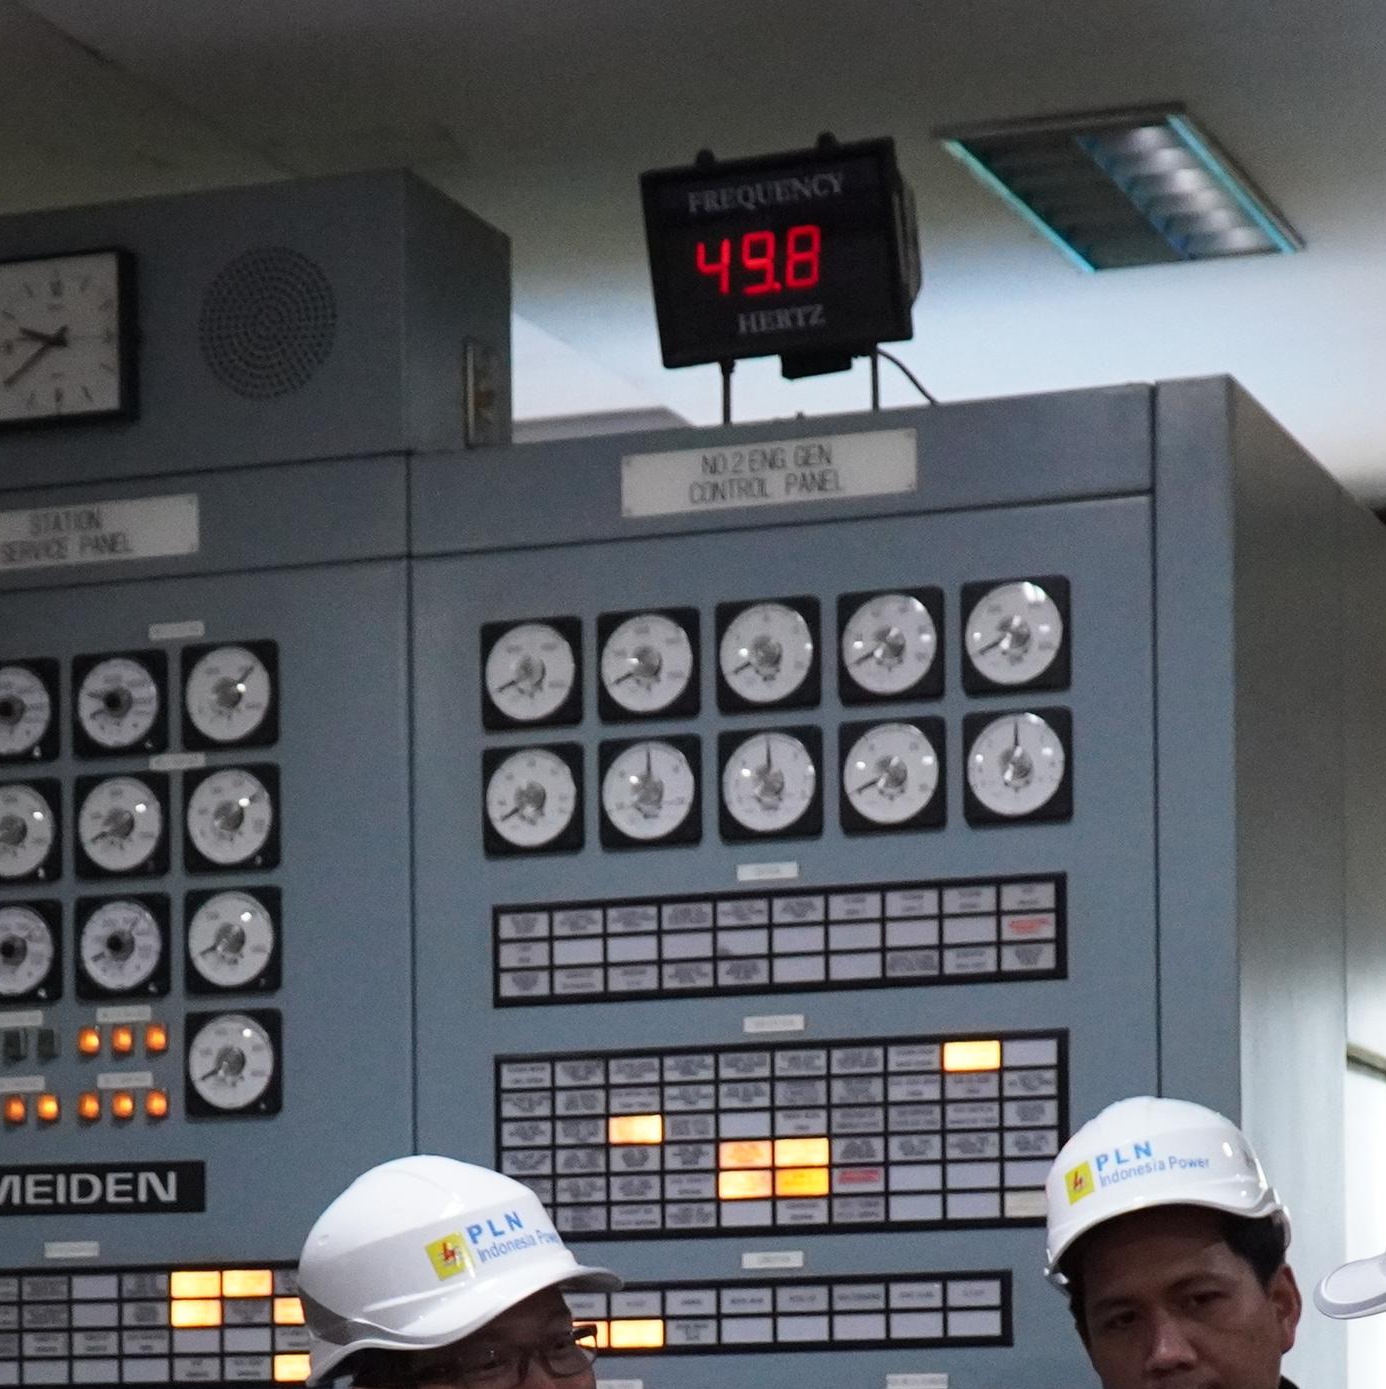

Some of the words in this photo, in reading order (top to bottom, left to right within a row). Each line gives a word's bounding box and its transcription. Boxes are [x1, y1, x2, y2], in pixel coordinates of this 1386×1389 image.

[688, 172, 844, 213] FREQUENCY
[696, 224, 822, 296] 49.8
[739, 304, 826, 335] HERTZ
[793, 443, 833, 468] GEN
[689, 477, 770, 504] CONTROL
[784, 469, 841, 496] PANEL
[29, 506, 103, 535] STATION
[0, 537, 69, 564] SERVICE
[79, 532, 134, 555] PANEL
[1096, 1140, 1153, 1172] PLN
[1099, 1160, 1167, 1187] Indonesia
[1169, 1155, 1210, 1171] Power
[466, 1211, 524, 1244] PLN
[476, 1232, 537, 1263] Indonesia
